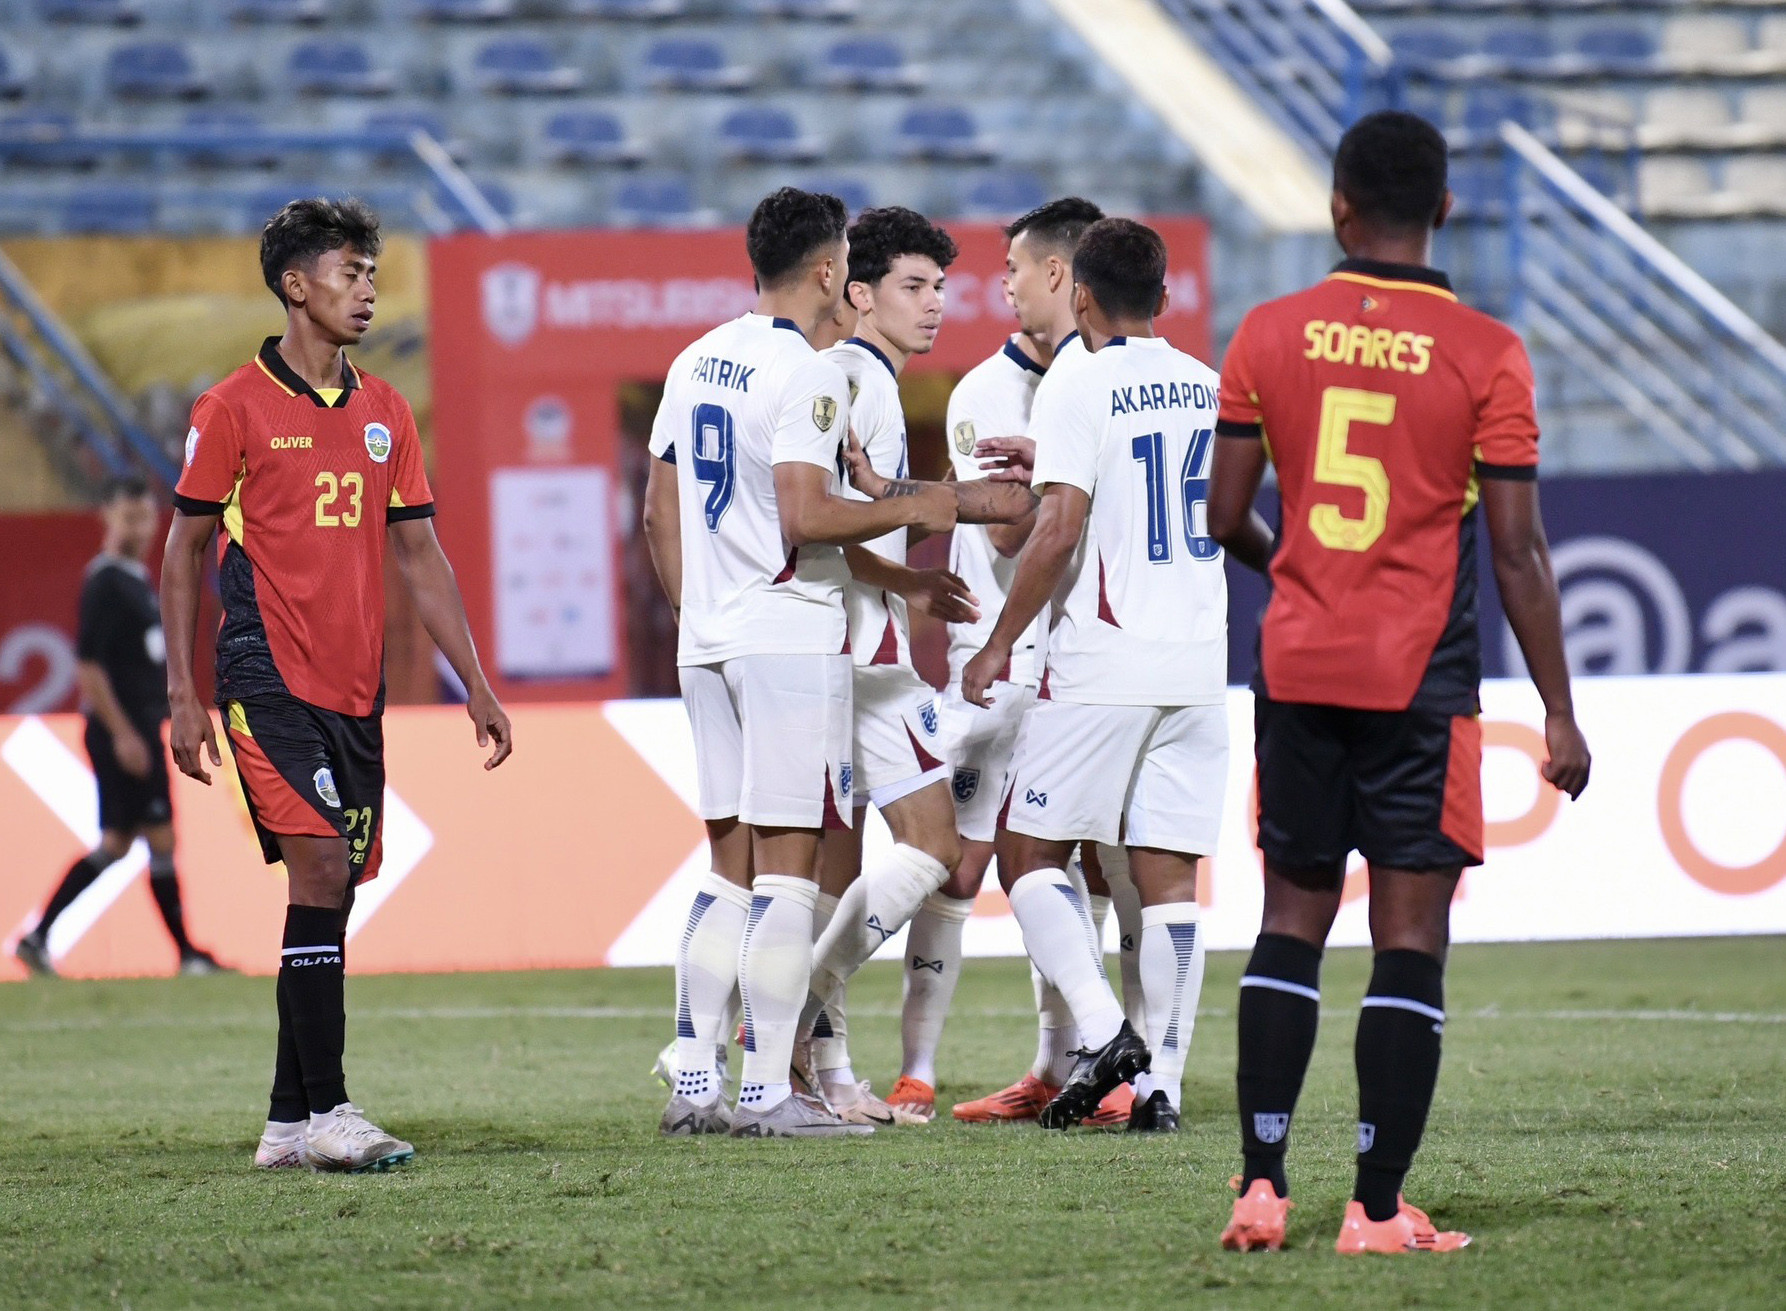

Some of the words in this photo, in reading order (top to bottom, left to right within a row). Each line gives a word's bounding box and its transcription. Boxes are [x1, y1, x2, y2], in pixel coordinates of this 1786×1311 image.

[691, 356, 756, 393] PATRIK
[1304, 320, 1434, 375] SOARES
[1111, 382, 1221, 417] AKARAPON
[692, 403, 736, 533] 9
[1308, 386, 1397, 552] 5
[315, 471, 364, 528] 23
[1132, 429, 1222, 565] 16
[291, 956, 341, 967] OLIVE
